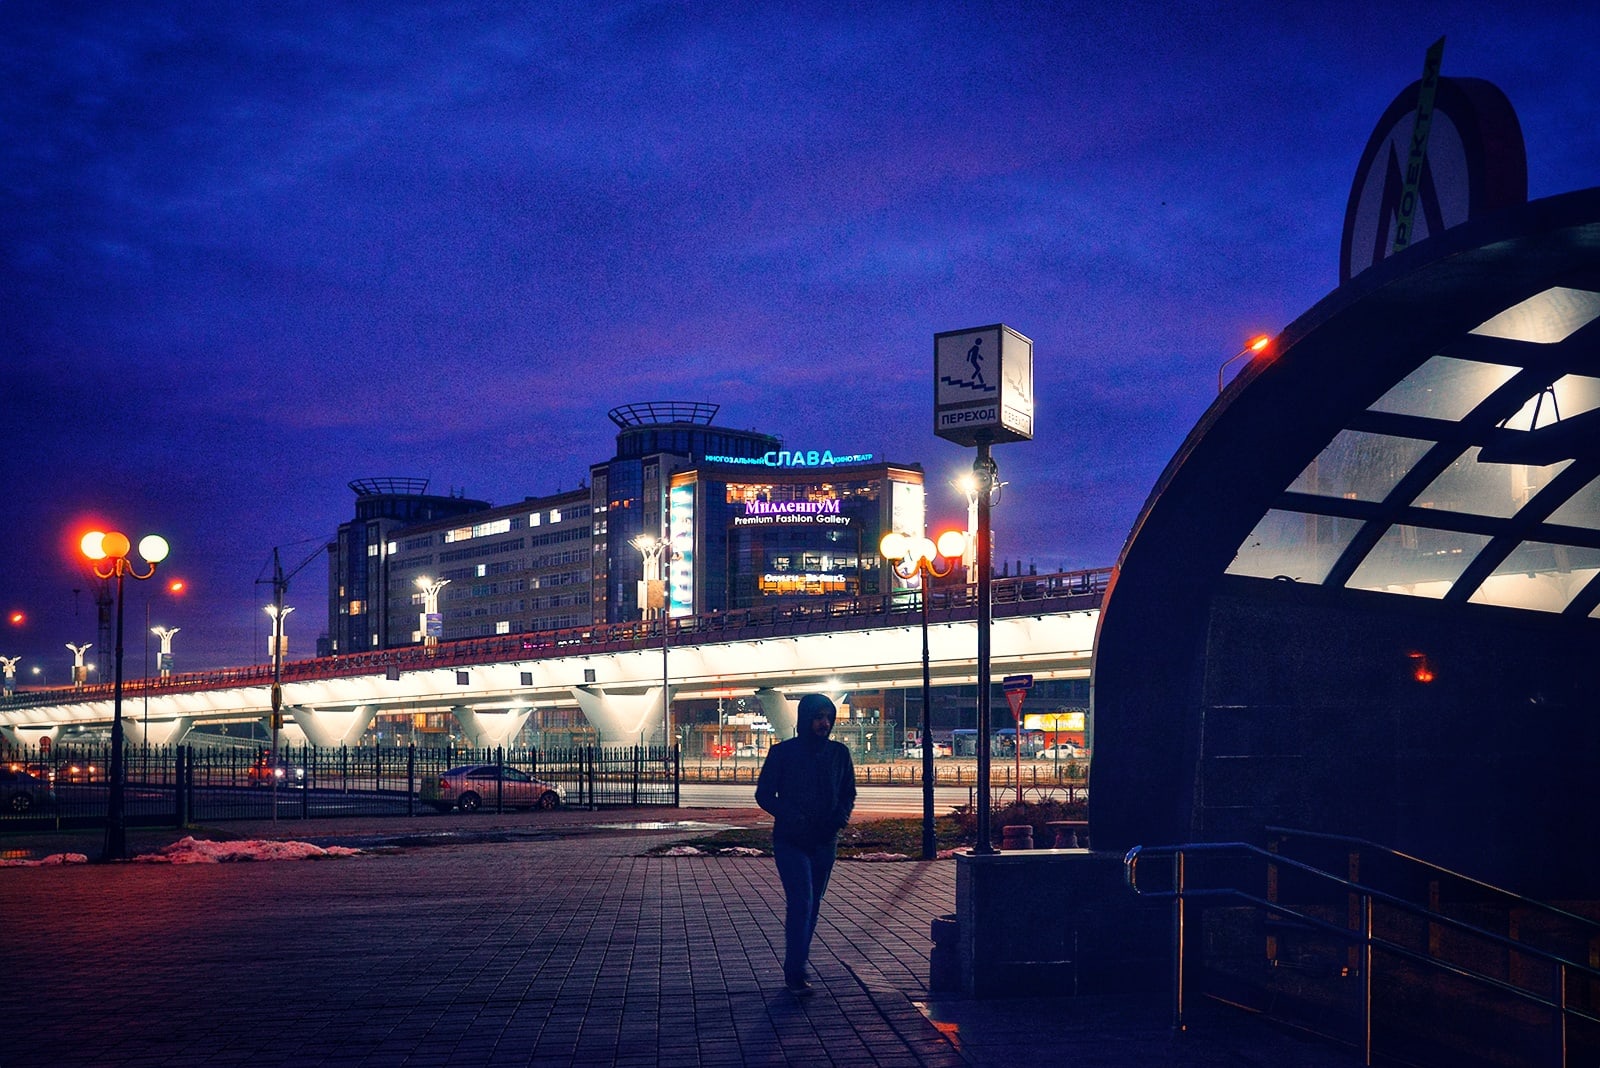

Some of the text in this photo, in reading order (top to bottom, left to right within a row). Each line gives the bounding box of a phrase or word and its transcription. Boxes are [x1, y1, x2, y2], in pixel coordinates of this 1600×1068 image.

[942, 408, 996, 425] ПЕРЕХОД
[764, 450, 834, 467] СЛАВА
[734, 514, 850, 526] Premium Fashion Gallery
